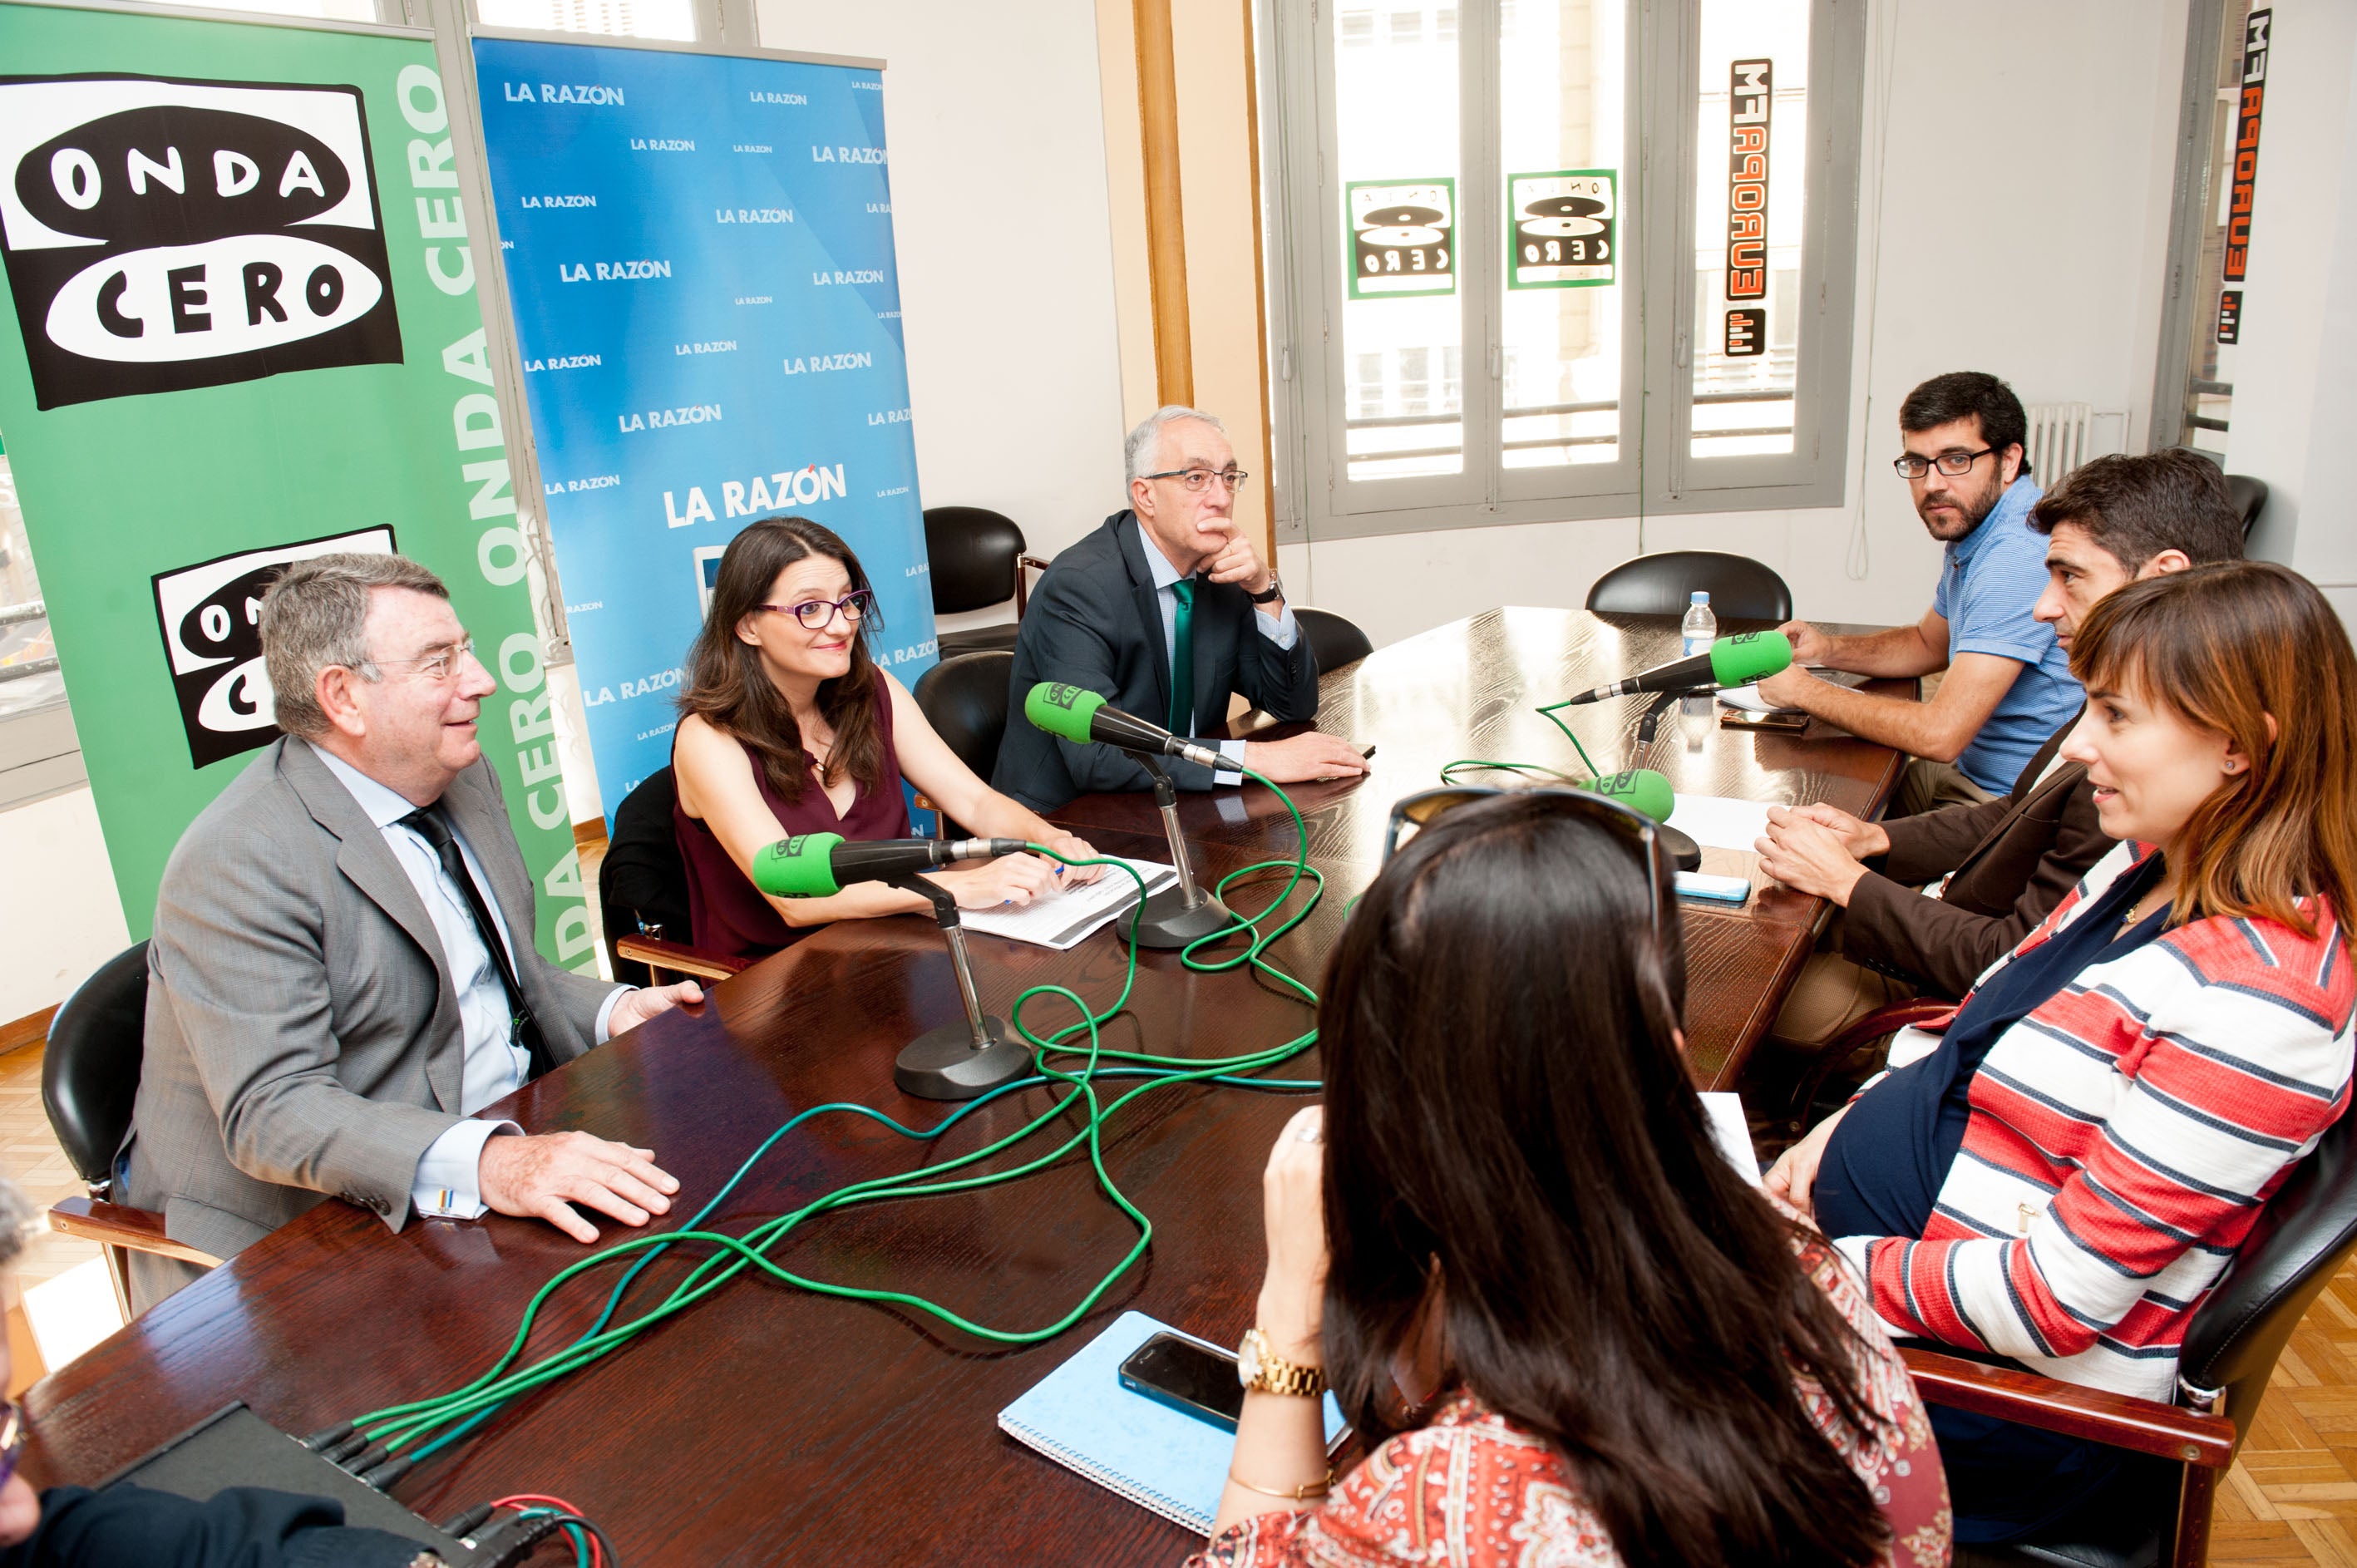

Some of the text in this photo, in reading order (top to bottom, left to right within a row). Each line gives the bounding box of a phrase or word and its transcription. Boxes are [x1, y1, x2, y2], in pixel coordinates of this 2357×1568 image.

[505, 82, 625, 106] LA RAZÓN
[750, 91, 765, 102] LA
[630, 139, 647, 150] LA
[812, 146, 836, 163] LA
[51, 147, 325, 210] ONDA
[397, 64, 476, 296] CERO
[521, 196, 542, 208] LA
[866, 203, 878, 213] LA
[716, 209, 737, 223] LA
[560, 259, 672, 283] LA RAZÓN
[813, 273, 832, 286] LA
[97, 262, 344, 338] CERO
[675, 343, 692, 356] LA
[525, 360, 545, 372] LA
[785, 357, 807, 374] LA
[619, 414, 645, 432] LA
[868, 407, 911, 426] LA RAZ
[441, 326, 526, 586] ONDA
[545, 482, 566, 496] LA
[663, 463, 846, 529] LA RAZÓN
[905, 567, 917, 577] LA
[584, 687, 616, 707] LA
[499, 632, 570, 830] CERO
[638, 732, 648, 741] LA
